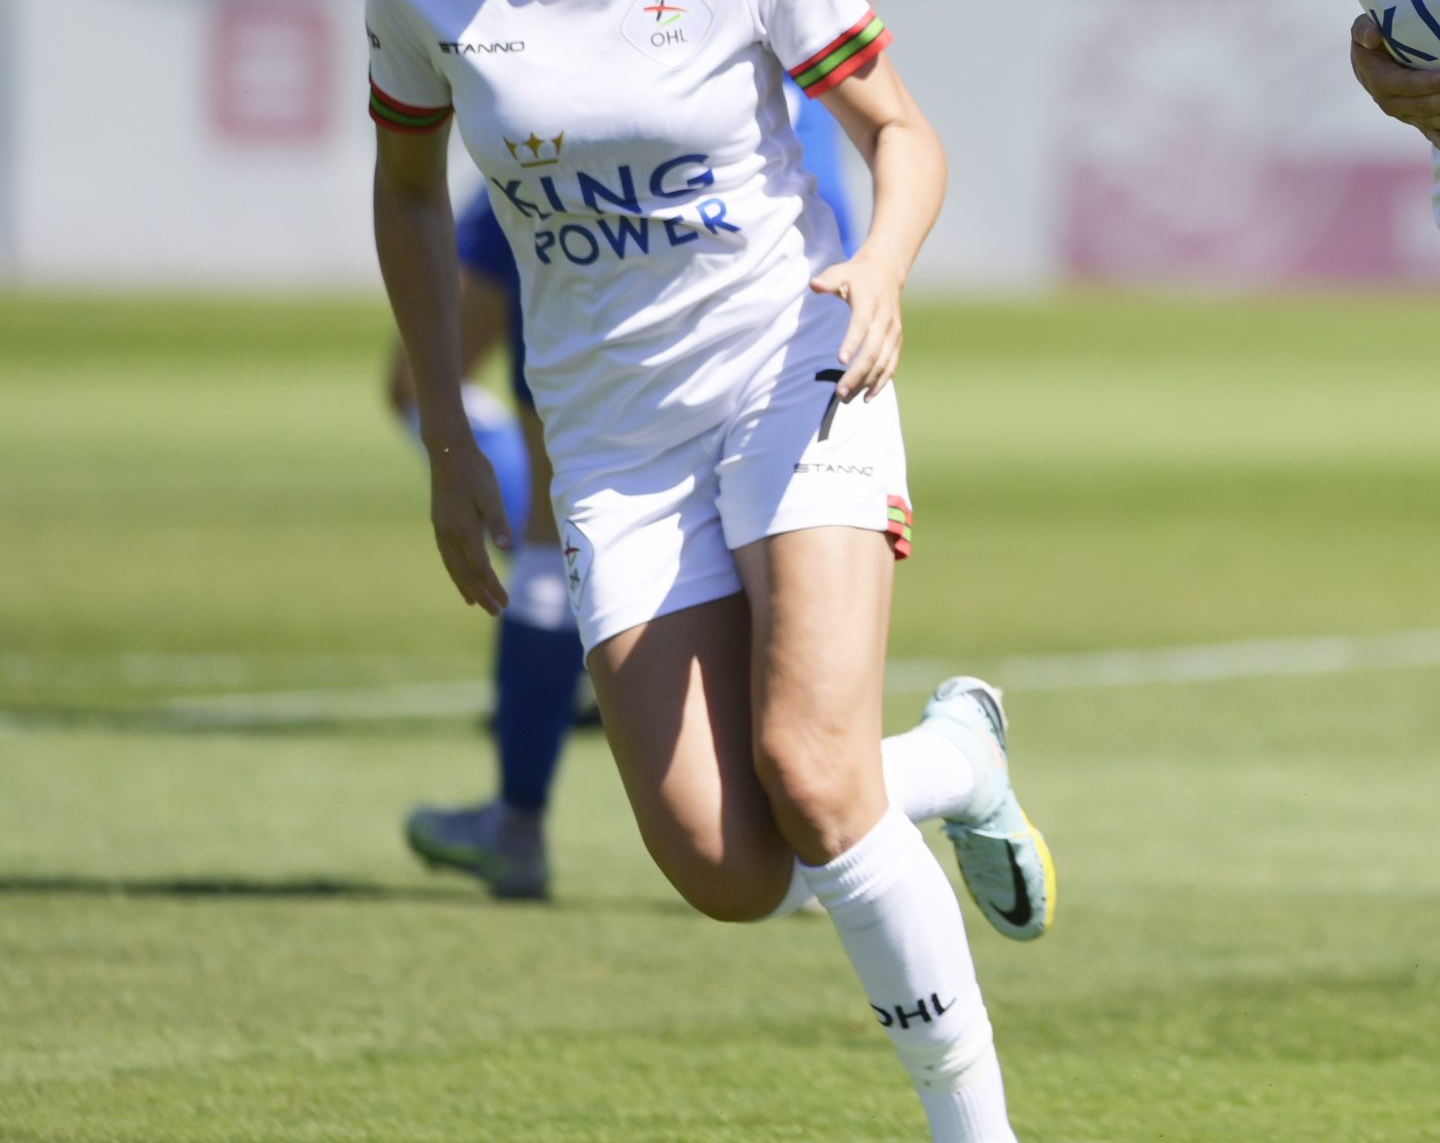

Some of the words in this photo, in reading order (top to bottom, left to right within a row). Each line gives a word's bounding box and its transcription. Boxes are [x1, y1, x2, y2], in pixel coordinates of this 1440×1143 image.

[438, 41, 525, 55] STANNO
[650, 28, 688, 47] OHL
[492, 154, 714, 220] KING
[535, 198, 741, 266] POWER
[814, 368, 846, 443] 7
